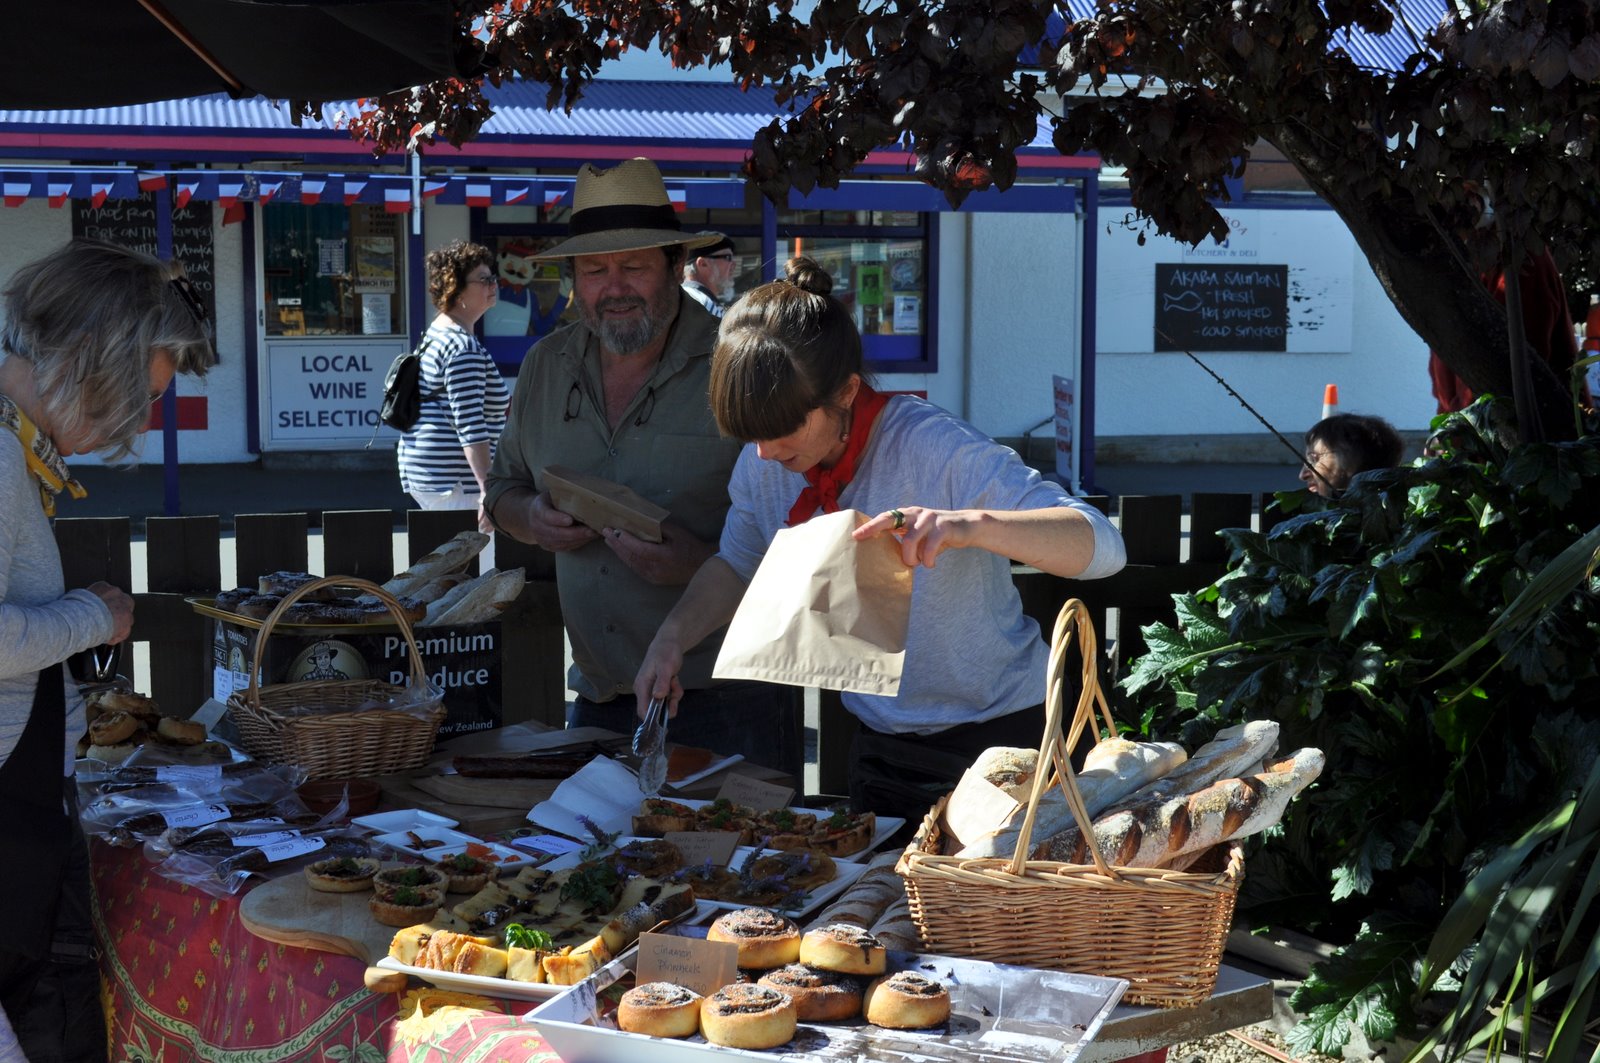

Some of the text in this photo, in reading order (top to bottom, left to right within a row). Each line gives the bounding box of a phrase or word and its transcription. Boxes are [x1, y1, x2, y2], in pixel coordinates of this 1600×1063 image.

[1214, 289, 1255, 304] FRESH
[301, 355, 373, 373] LOCAL
[309, 382, 367, 399] WINE
[278, 409, 383, 428] SELECTIO
[384, 631, 494, 659] Premium
[389, 665, 489, 689] Prduce
[437, 719, 493, 734] ew Zealand
